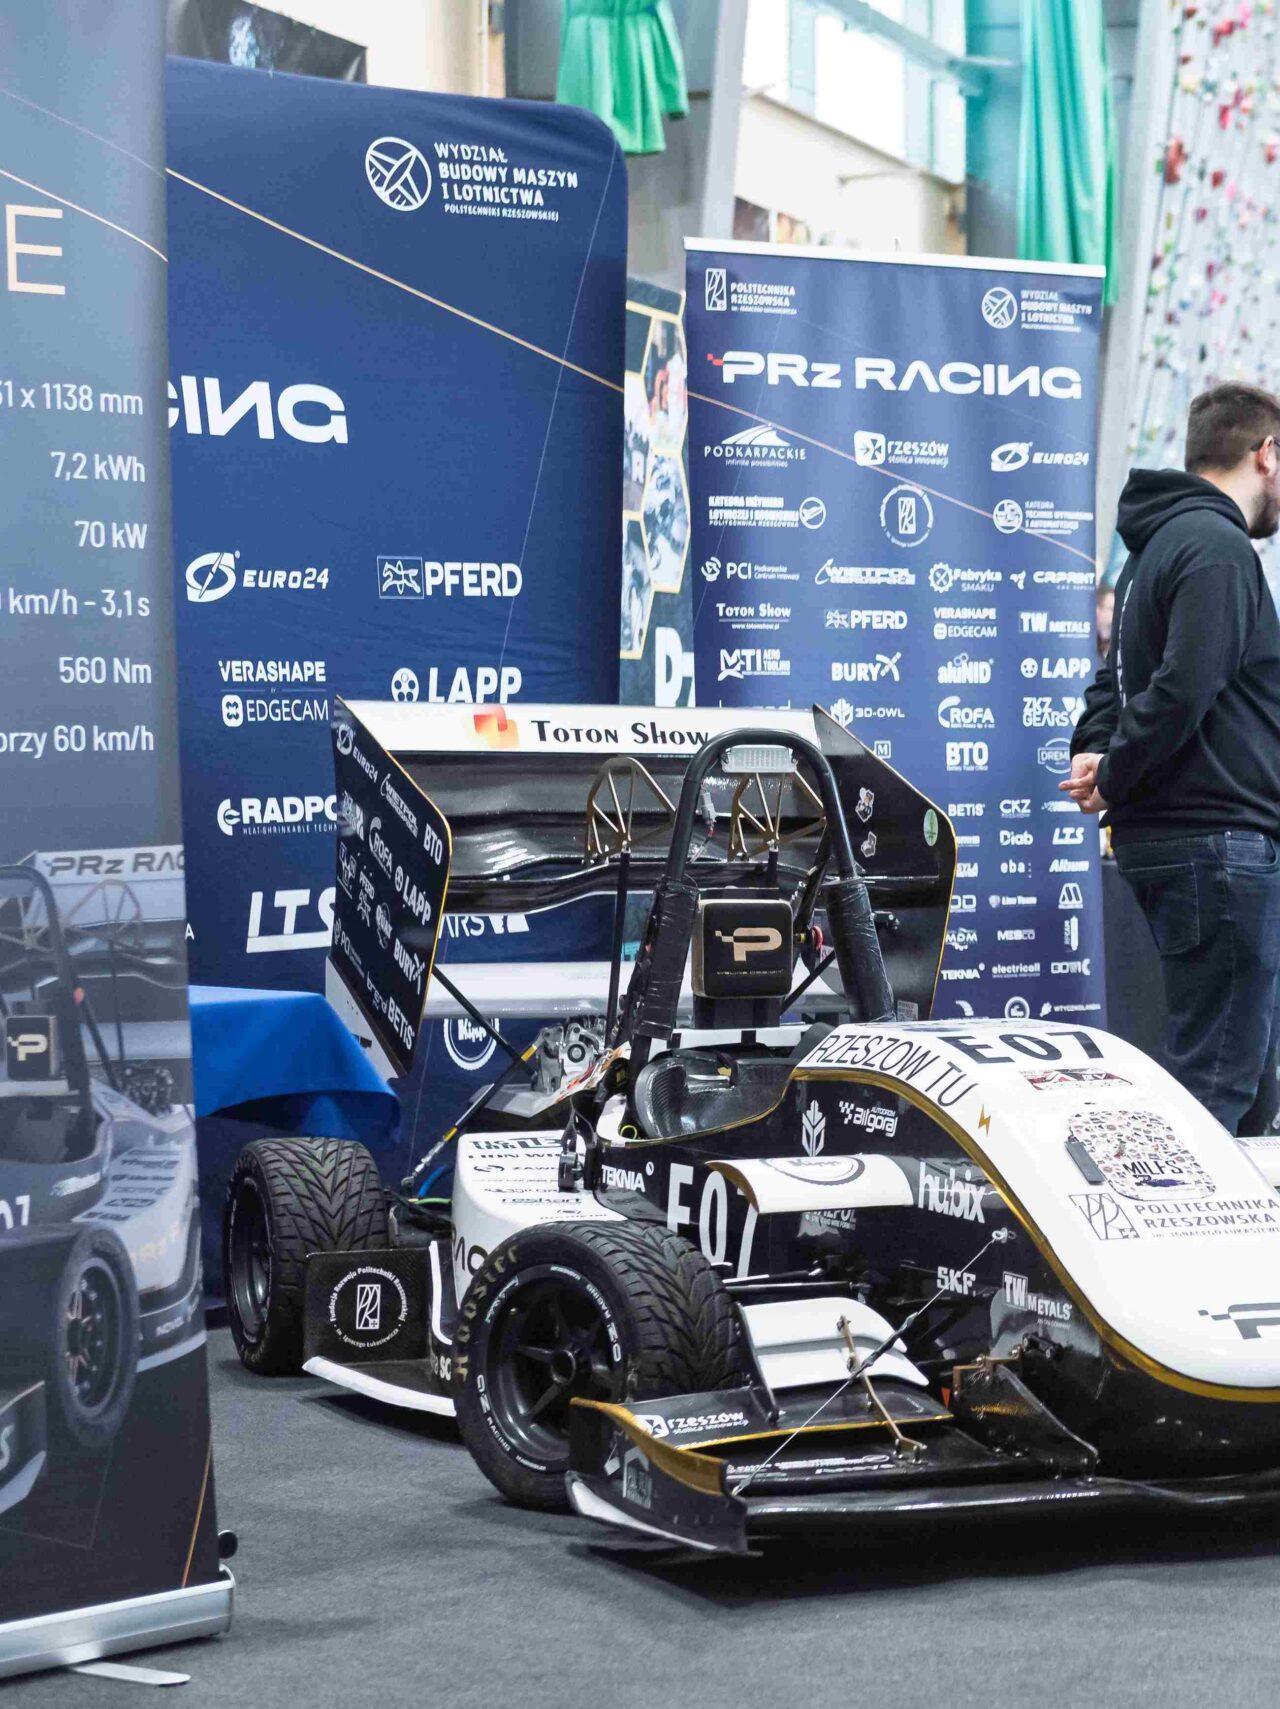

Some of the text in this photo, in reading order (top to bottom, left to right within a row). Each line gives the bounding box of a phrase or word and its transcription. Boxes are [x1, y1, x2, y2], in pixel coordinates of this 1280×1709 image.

[434, 142, 509, 164] WYDZIAŁ
[438, 162, 578, 188] BUDOWY MASZYN
[441, 182, 544, 206] I LOTNICTWA
[731, 282, 796, 296] POLITECHNIKA
[731, 294, 790, 307] RZESZOWSKA
[722, 350, 1082, 399] PRz RACING
[20, 388, 36, 409] x
[42, 383, 93, 412] 1138
[99, 392, 144, 415] mm
[167, 375, 348, 444] ING
[704, 445, 806, 460] PODKARPACKIE
[887, 440, 949, 457] rzeszów
[51, 450, 146, 483] 7,2 kWh
[75, 520, 147, 549] 70 kW
[243, 568, 329, 590] EURO24
[424, 561, 523, 597] PFERD
[726, 562, 752, 580] PCI
[9, 588, 78, 616] km/h
[851, 609, 907, 629] PFERD
[1020, 612, 1048, 632] TW
[948, 625, 997, 638] EDGECAM
[59, 657, 152, 684] 560 Nm
[219, 660, 326, 683] VERASHAPE
[1041, 657, 1091, 679] LAPP
[428, 667, 522, 703] LAPP
[247, 700, 329, 722] EDGECAM
[1023, 697, 1053, 713] ZKZ
[1023, 711, 1071, 727] GEARS
[54, 724, 86, 752] 60
[94, 725, 154, 751] km/h
[352, 746, 378, 783] EURO24
[946, 741, 988, 766] BTO
[1000, 799, 1031, 815] CKZ
[424, 823, 443, 866] BTO
[1000, 830, 1033, 846] Diab
[403, 875, 432, 926] LAPP
[806, 1034, 979, 1108] RZESZOW TU
[602, 1164, 646, 1193] TEKNIA
[918, 1161, 987, 1223] hubix
[1134, 1198, 1280, 1215] POLITECHNIKA
[1143, 1213, 1276, 1228] RZESZOWSKA
[1004, 1274, 1072, 1320] TW METALS
[667, 1412, 743, 1429] rzeszów
